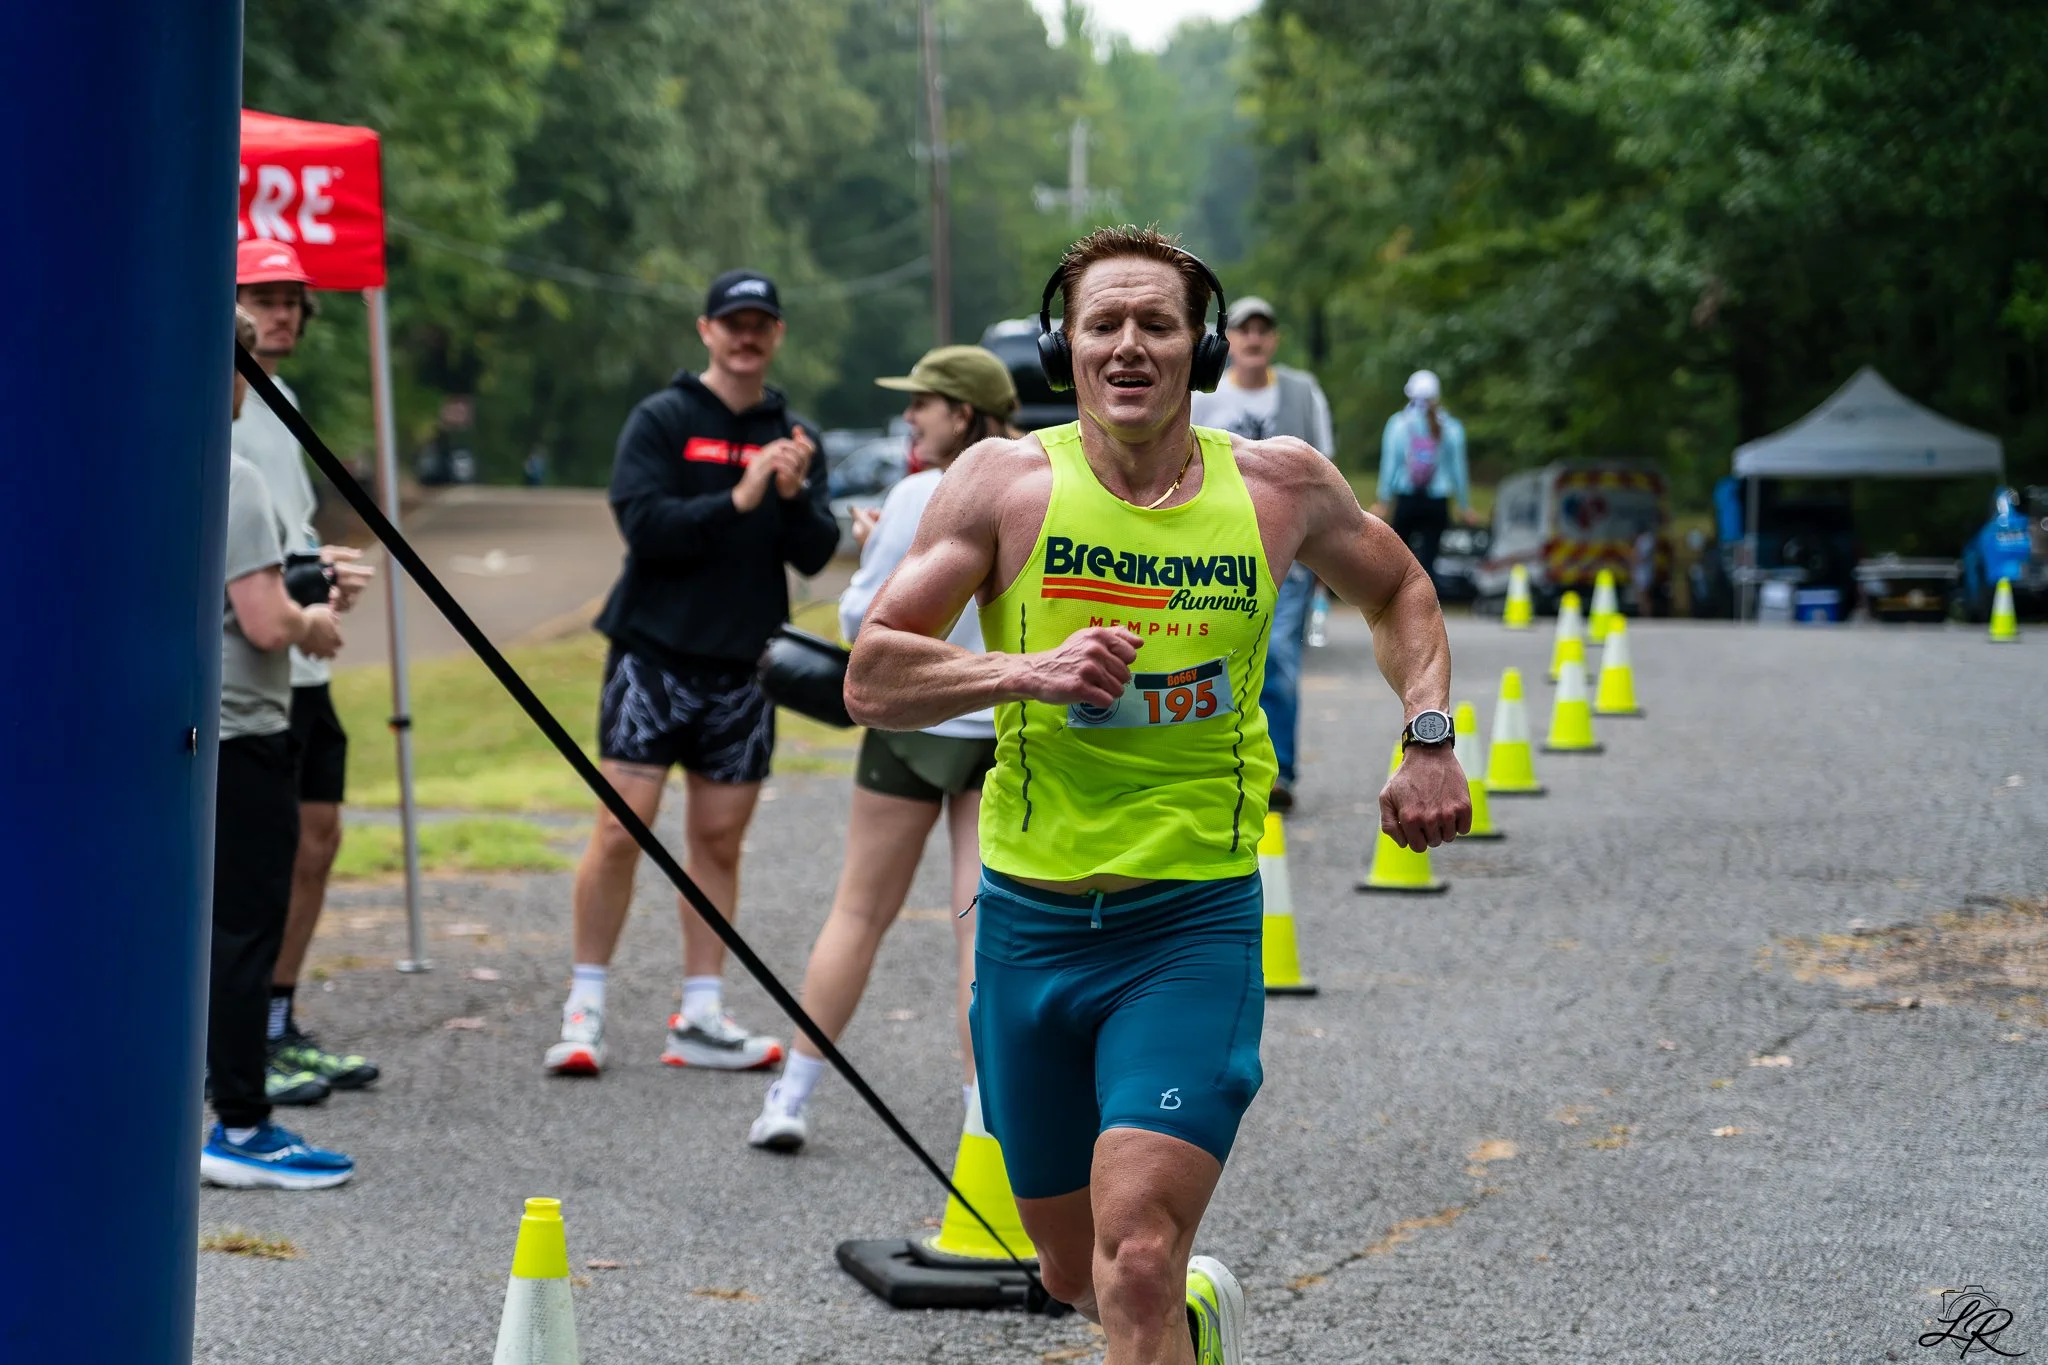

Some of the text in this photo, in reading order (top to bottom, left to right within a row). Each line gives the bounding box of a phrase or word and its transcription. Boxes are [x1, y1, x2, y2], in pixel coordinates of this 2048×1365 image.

[238, 164, 336, 245] RE
[1044, 536, 1257, 597] Breakaway
[1168, 588, 1260, 619] Running
[1089, 616, 1209, 636] MEMPHIS
[1143, 680, 1218, 724] 195
